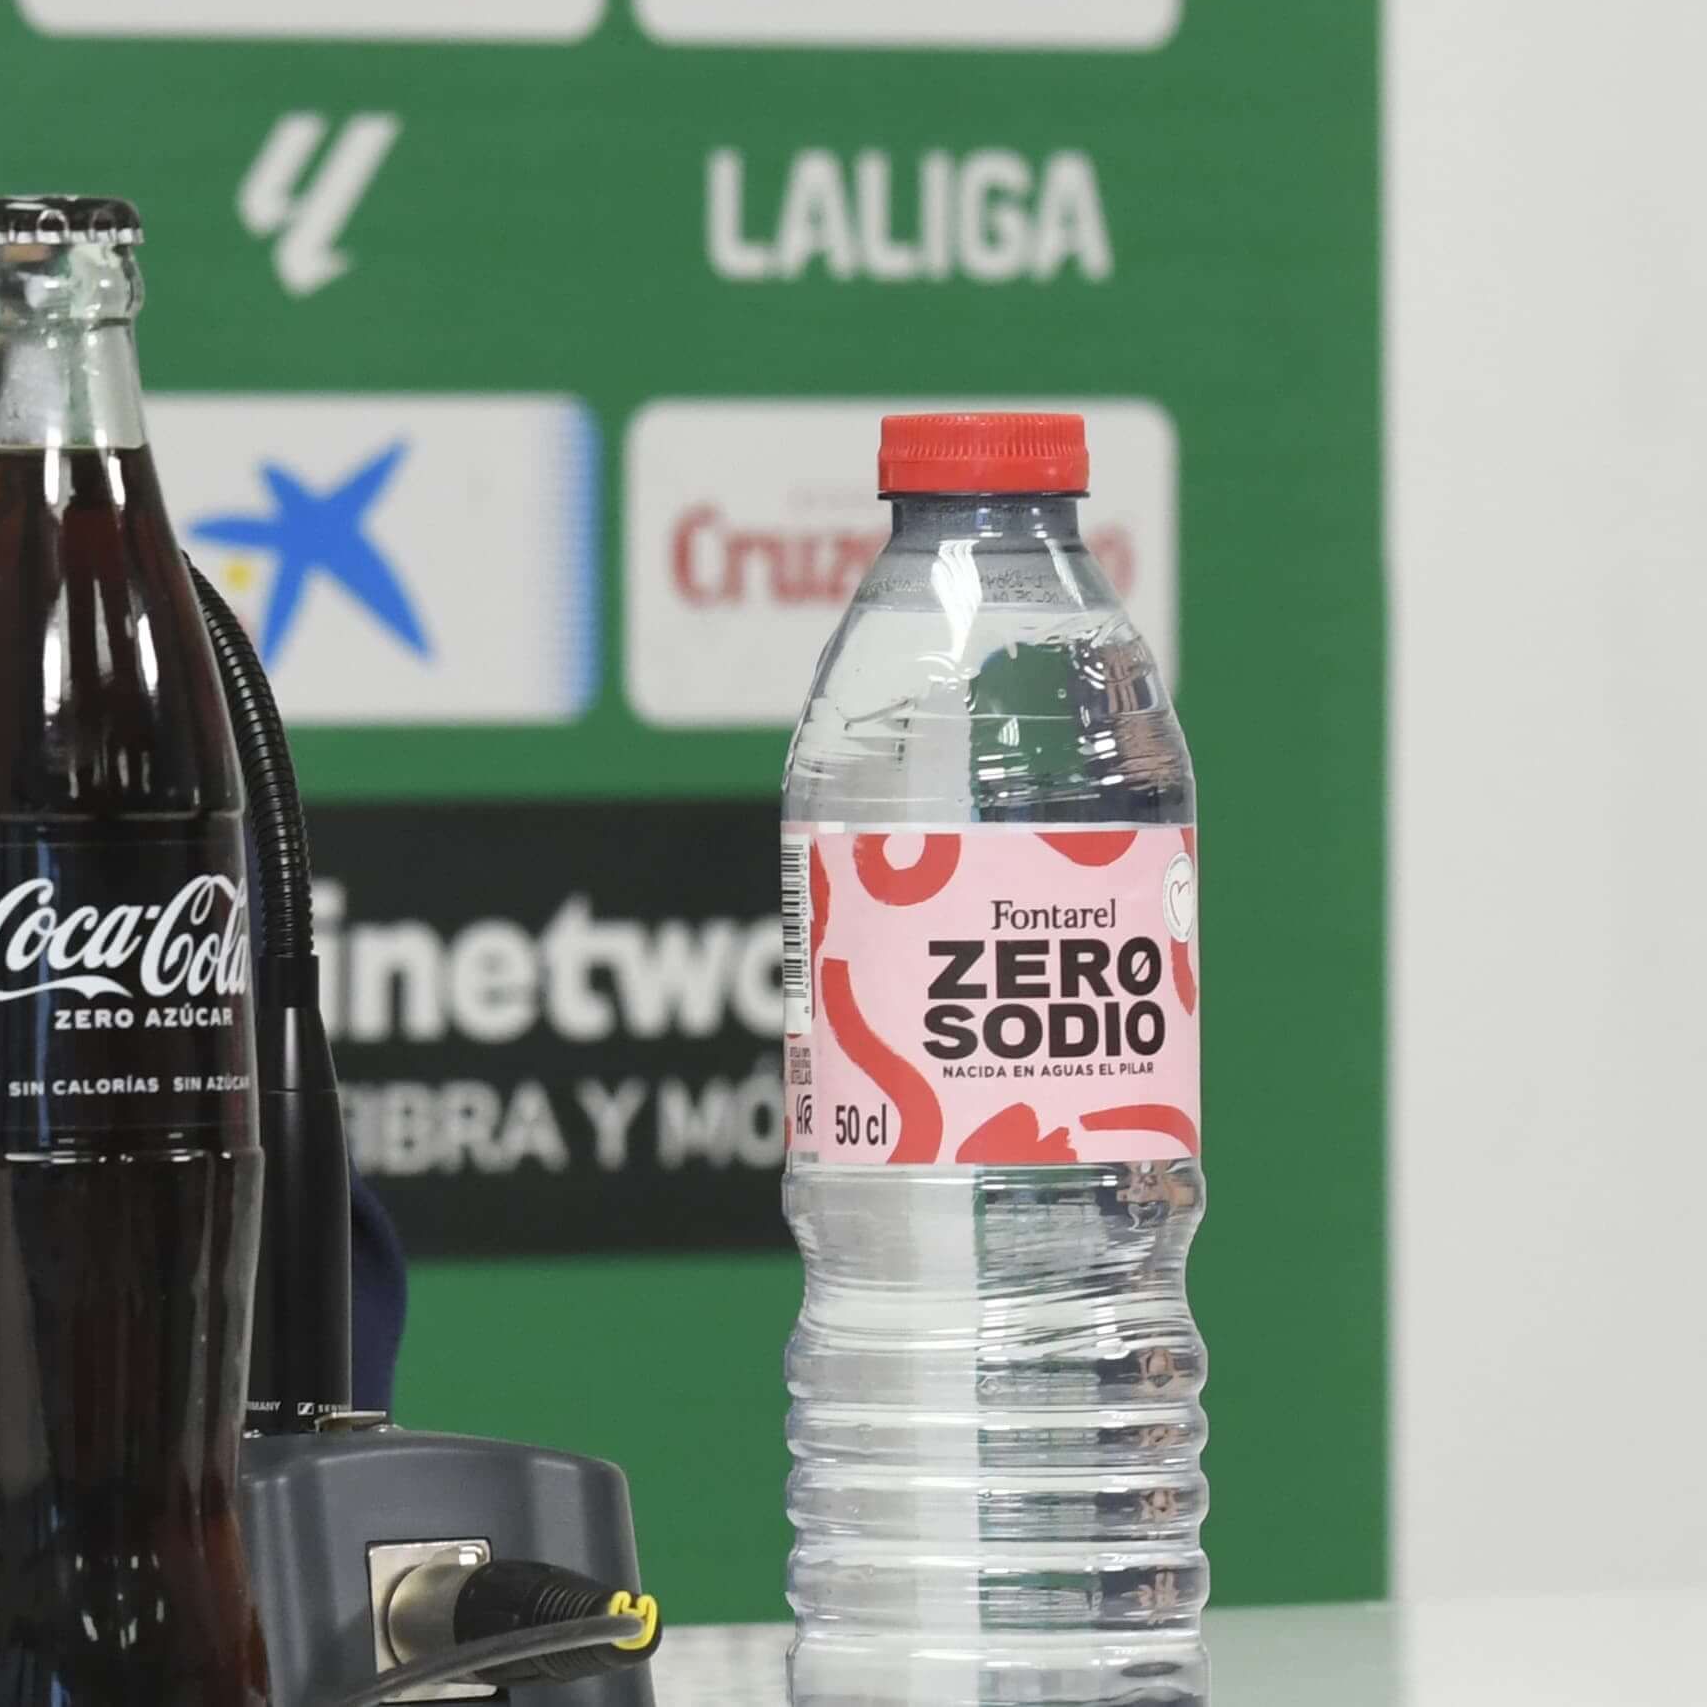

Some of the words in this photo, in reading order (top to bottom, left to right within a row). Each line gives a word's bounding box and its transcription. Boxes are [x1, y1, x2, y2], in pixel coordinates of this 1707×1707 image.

[709, 150, 1111, 281] LALIGA
[992, 899, 1115, 929] Fontarel
[54, 1008, 134, 1031] ZERO
[144, 1002, 233, 1028] AZÚCAR
[923, 1000, 1165, 1060] SODIO
[8, 1081, 44, 1097] SIN
[52, 1076, 159, 1095] CALORÍAS
[174, 1077, 201, 1092] SIN
[943, 1066, 1006, 1078] NACIDA
[1014, 1065, 1034, 1077] EN
[1041, 1064, 1093, 1076] AGUAS
[1099, 1064, 1115, 1075] EL
[1120, 1062, 1153, 1074] PILAR
[581, 1083, 643, 1166] Y
[836, 1105, 859, 1145] 50
[867, 1104, 886, 1145] cl
